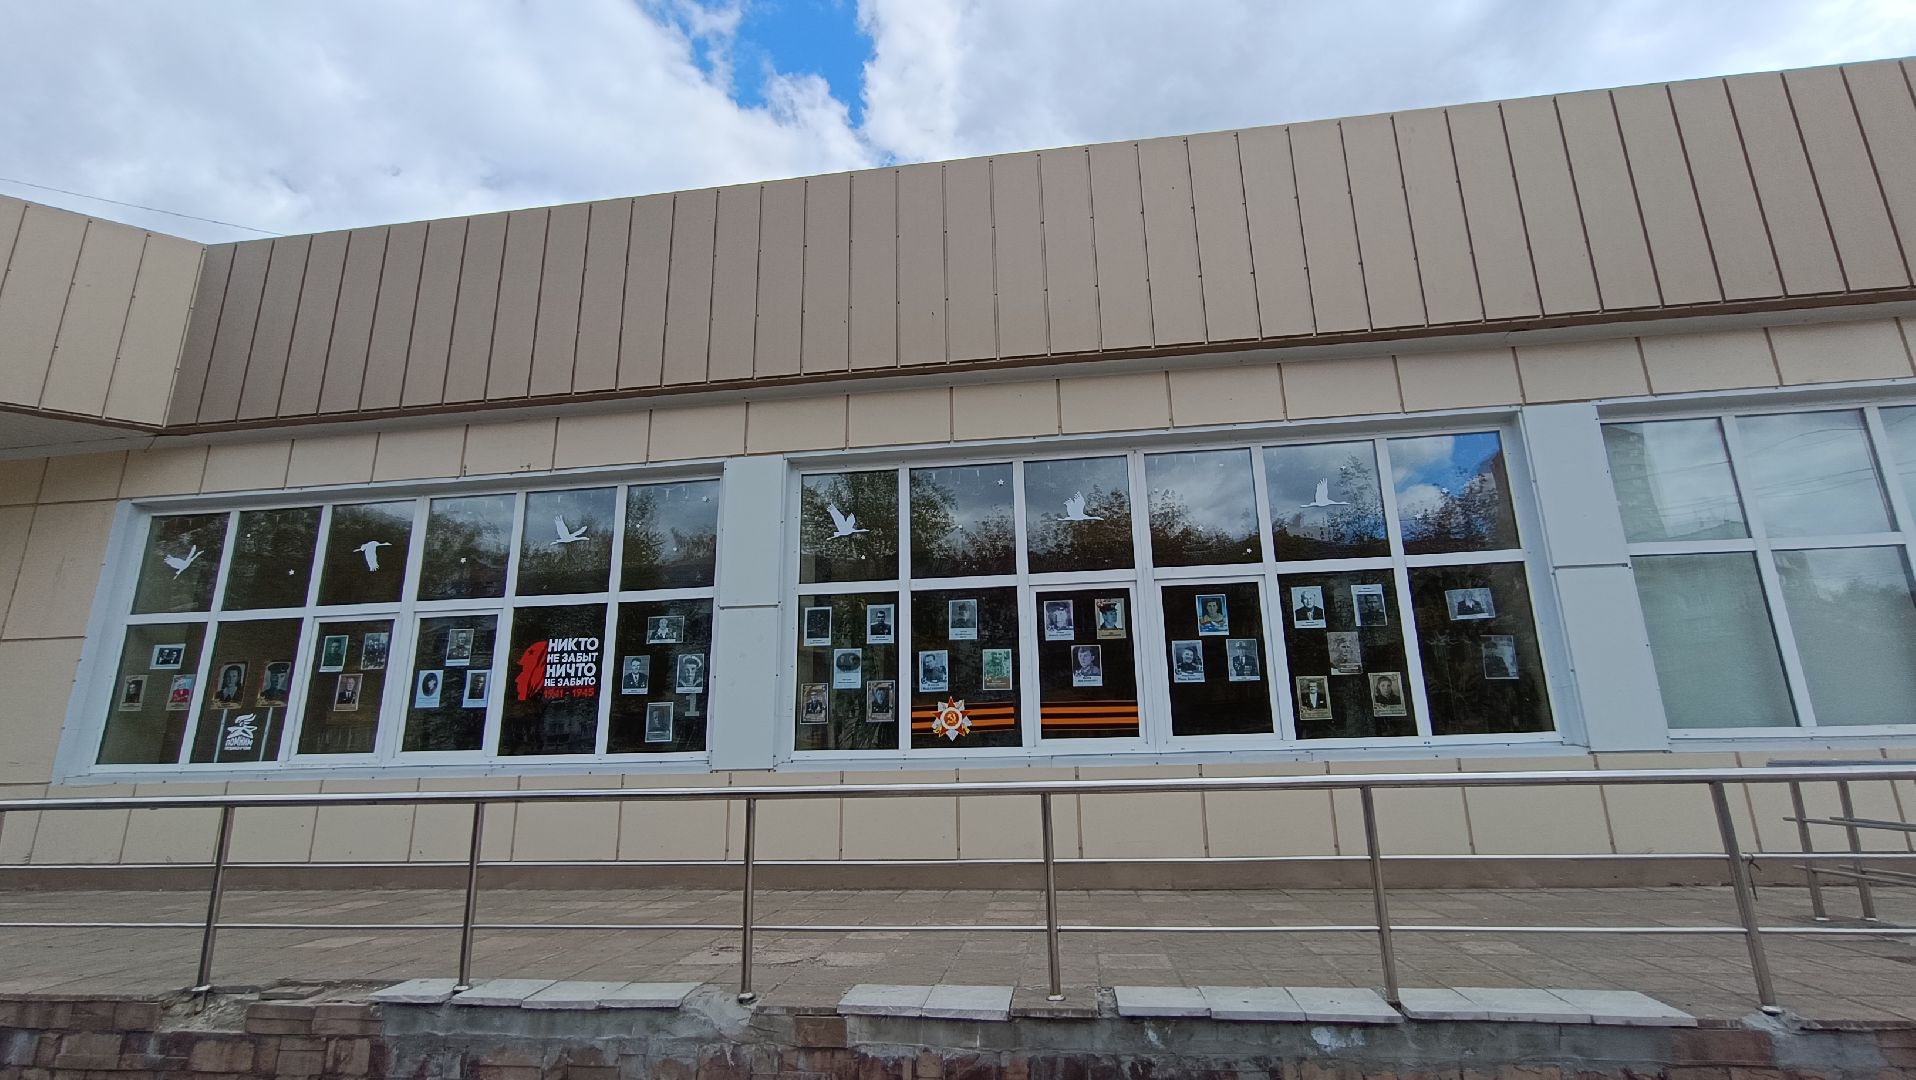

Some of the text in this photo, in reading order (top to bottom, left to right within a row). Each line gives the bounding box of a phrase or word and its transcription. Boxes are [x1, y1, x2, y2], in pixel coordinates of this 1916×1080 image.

[548, 638, 599, 652] НИКТО
[547, 652, 598, 663] НЕ ЗАБЫТ
[546, 663, 596, 677] НИЧТО
[558, 677, 596, 686] ЗАБЫТО
[572, 688, 594, 697] 1945
